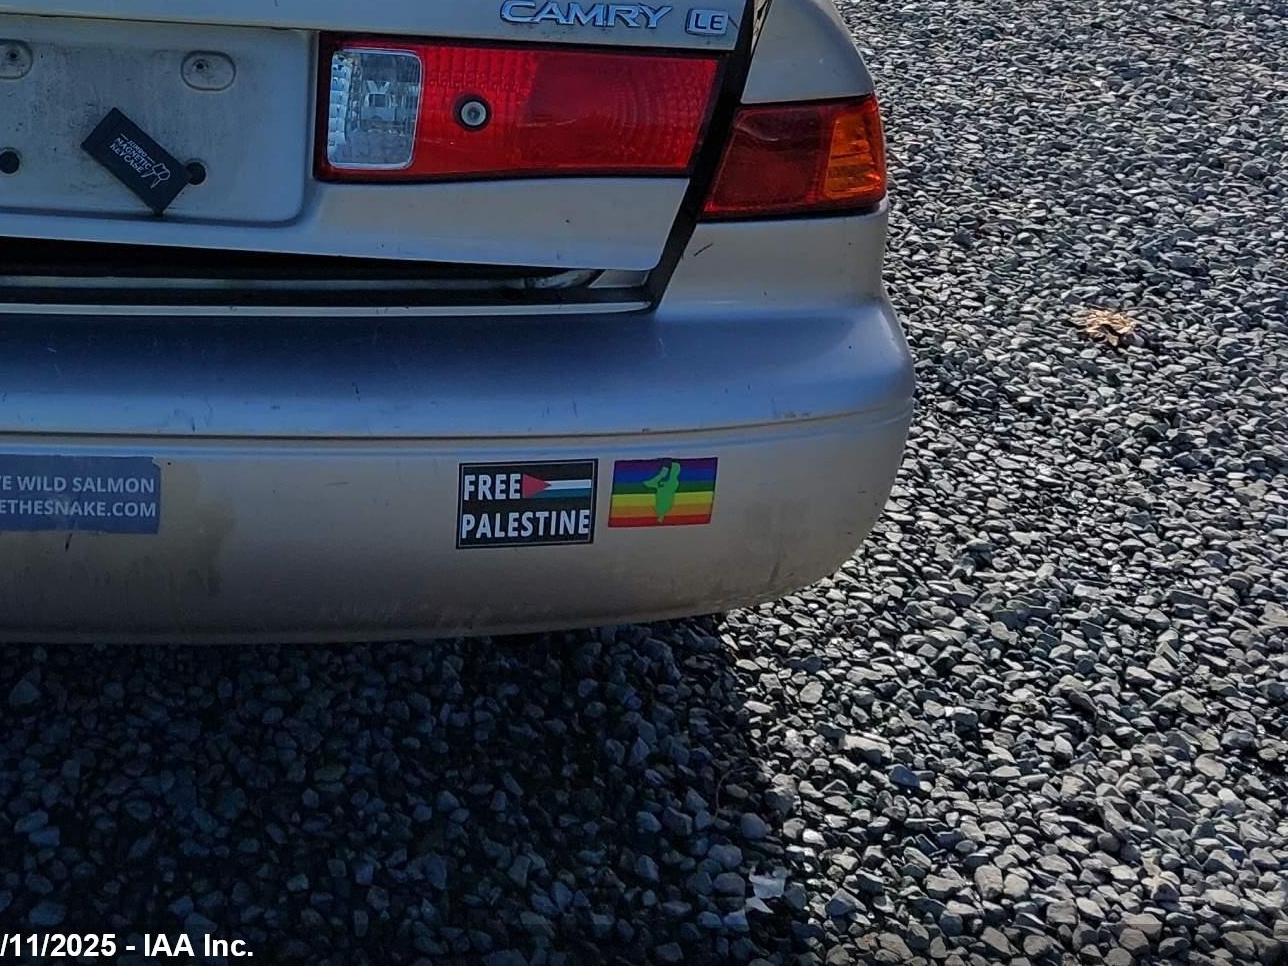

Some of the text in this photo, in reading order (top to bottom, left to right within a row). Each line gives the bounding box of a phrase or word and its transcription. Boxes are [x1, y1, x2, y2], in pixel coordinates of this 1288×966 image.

[693, 11, 724, 31] LE
[114, 137, 153, 170] MAGNETIC
[16, 475, 67, 493] WILD
[72, 476, 155, 494] SALMON
[463, 473, 521, 501] FREE
[461, 509, 591, 539] PALESTINE
